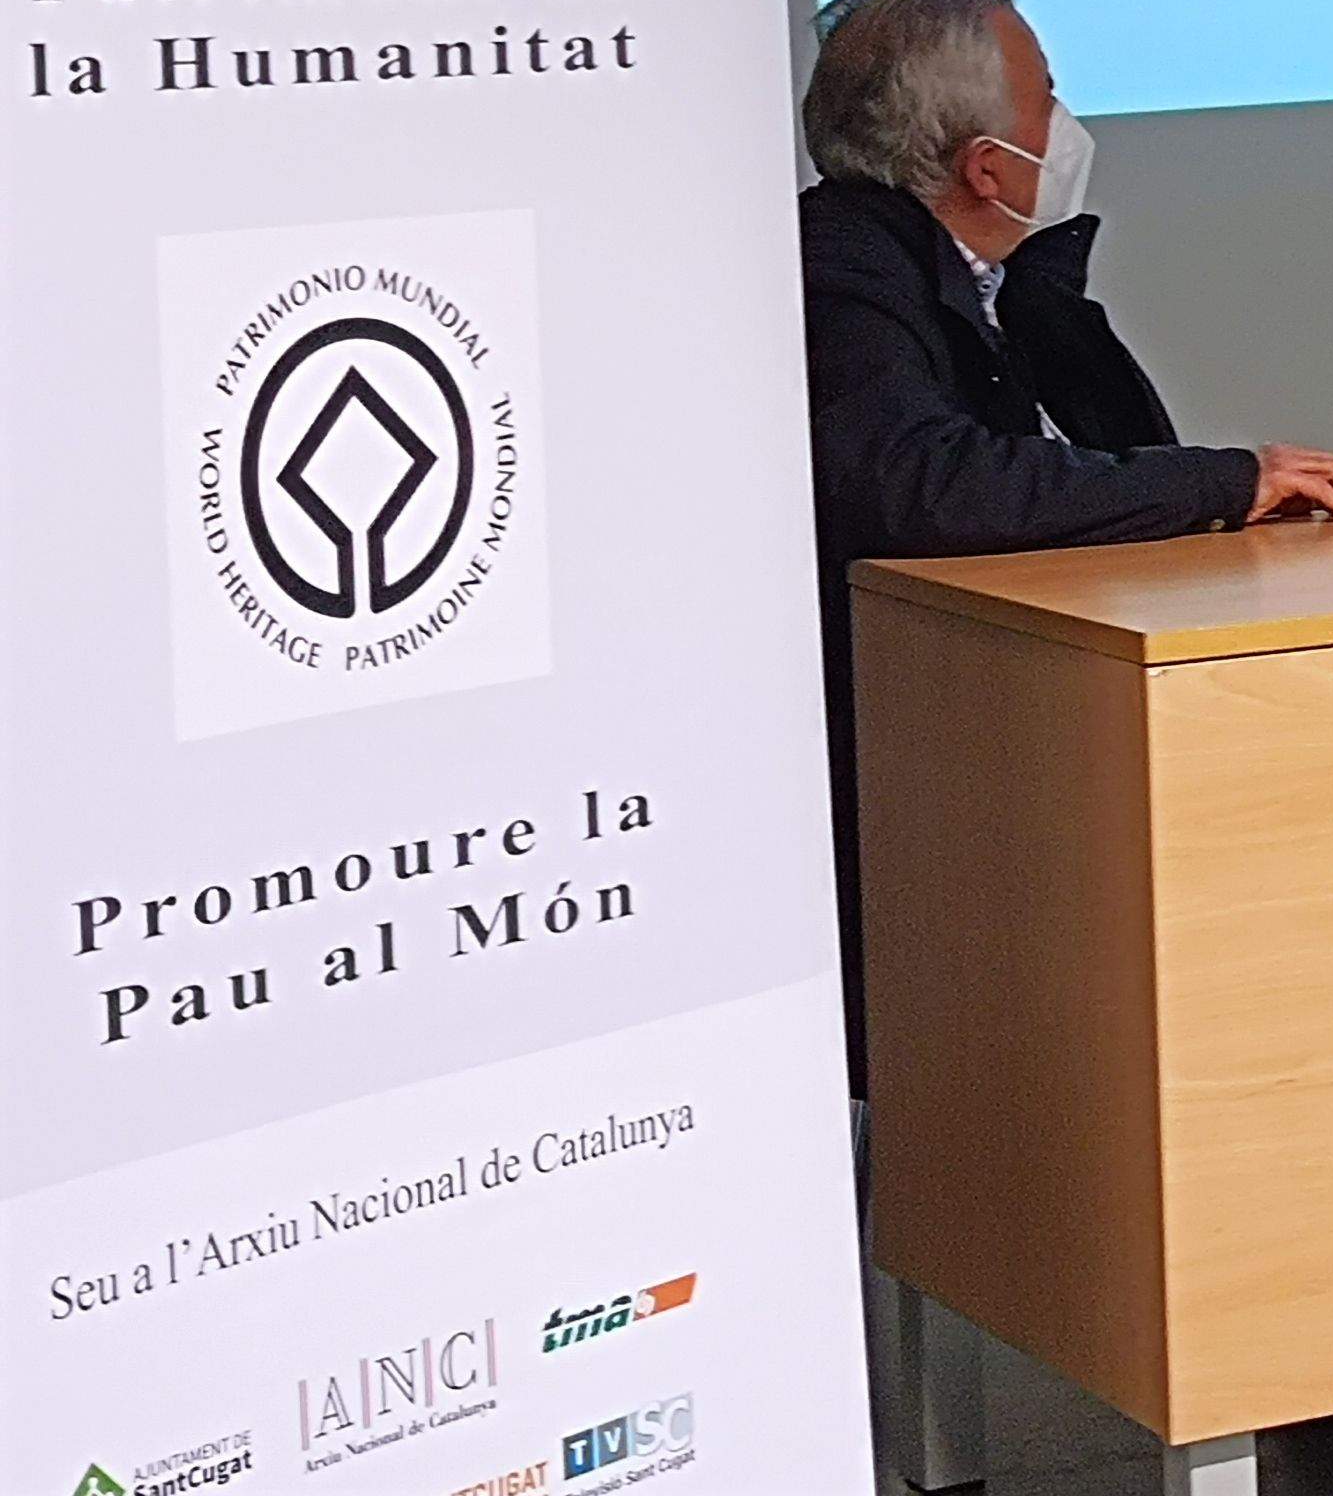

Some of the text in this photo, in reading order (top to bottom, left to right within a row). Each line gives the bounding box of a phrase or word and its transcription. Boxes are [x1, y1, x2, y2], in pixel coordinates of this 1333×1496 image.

[28, 25, 637, 98] la Humanitat
[215, 265, 491, 396] PATRIMONIO MUNDIAL
[199, 427, 323, 670] WORLD HERITAGE
[345, 392, 518, 672] PATRIMOINE MONDIAL
[71, 790, 653, 957] Promoure la
[99, 881, 635, 1046] Pau al Món
[49, 1268, 120, 1321] Seu
[132, 1262, 154, 1295] a
[309, 1157, 468, 1241] Nacional
[480, 1147, 521, 1189] de
[532, 1103, 695, 1174] Catalunya
[234, 1429, 252, 1449] DE
[345, 1424, 403, 1455] Nacional
[408, 1420, 425, 1435] de
[429, 1399, 497, 1428] Catalunya
[627, 1465, 655, 1485] Sant
[659, 1450, 696, 1472] Cugat
